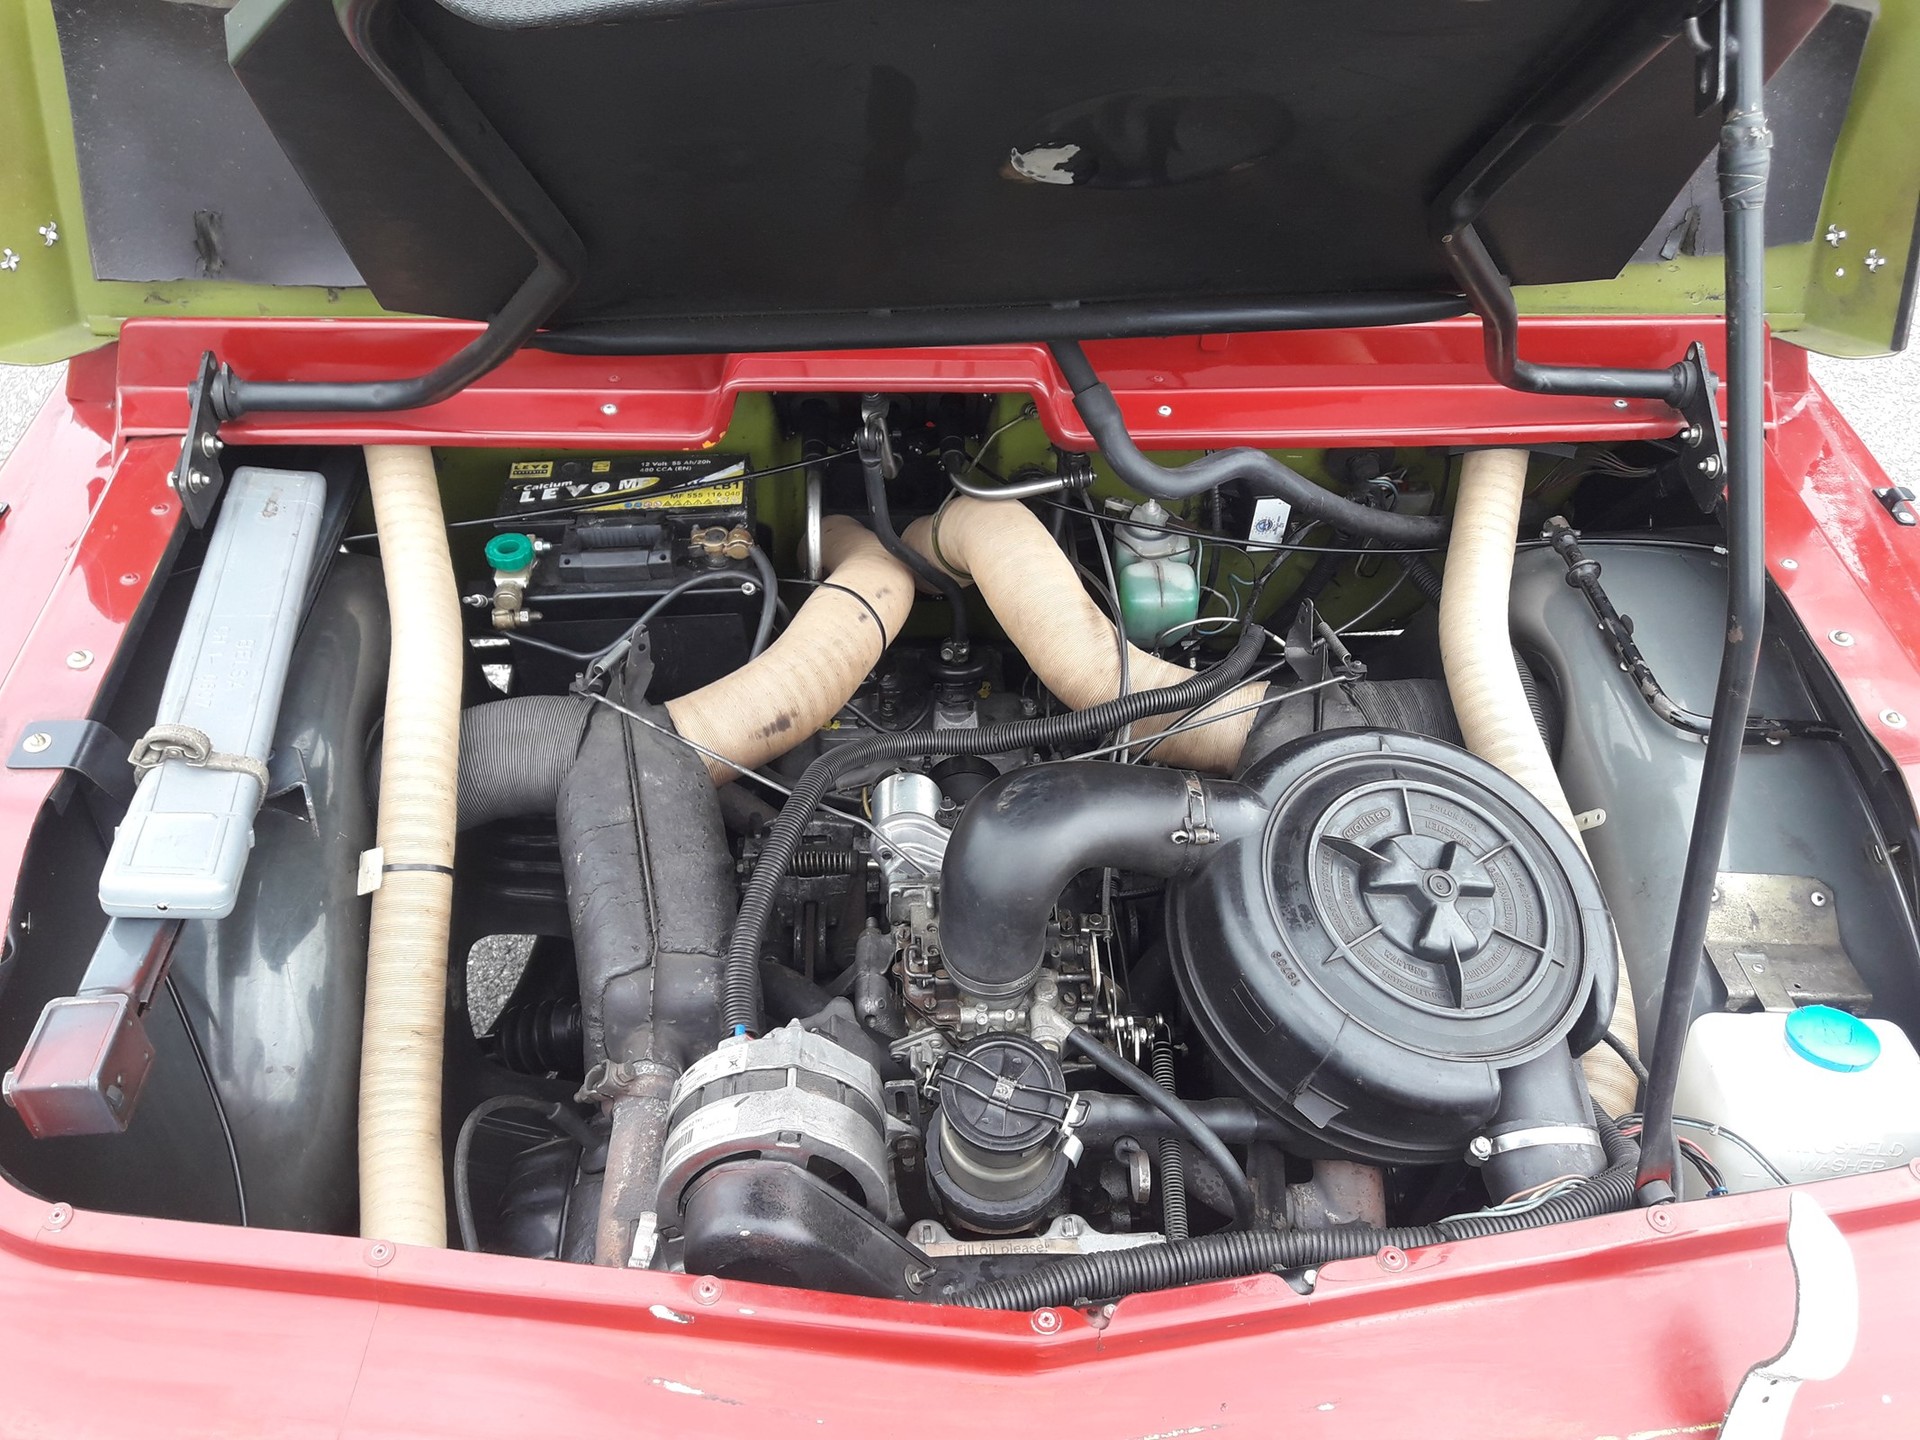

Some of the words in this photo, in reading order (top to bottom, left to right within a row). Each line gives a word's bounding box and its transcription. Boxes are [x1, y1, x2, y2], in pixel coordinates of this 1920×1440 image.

[519, 481, 611, 503] LEVO
[618, 479, 650, 490] MF
[523, 480, 573, 491] Calcium
[956, 1243, 975, 1256] Fill
[980, 1243, 997, 1255] oil
